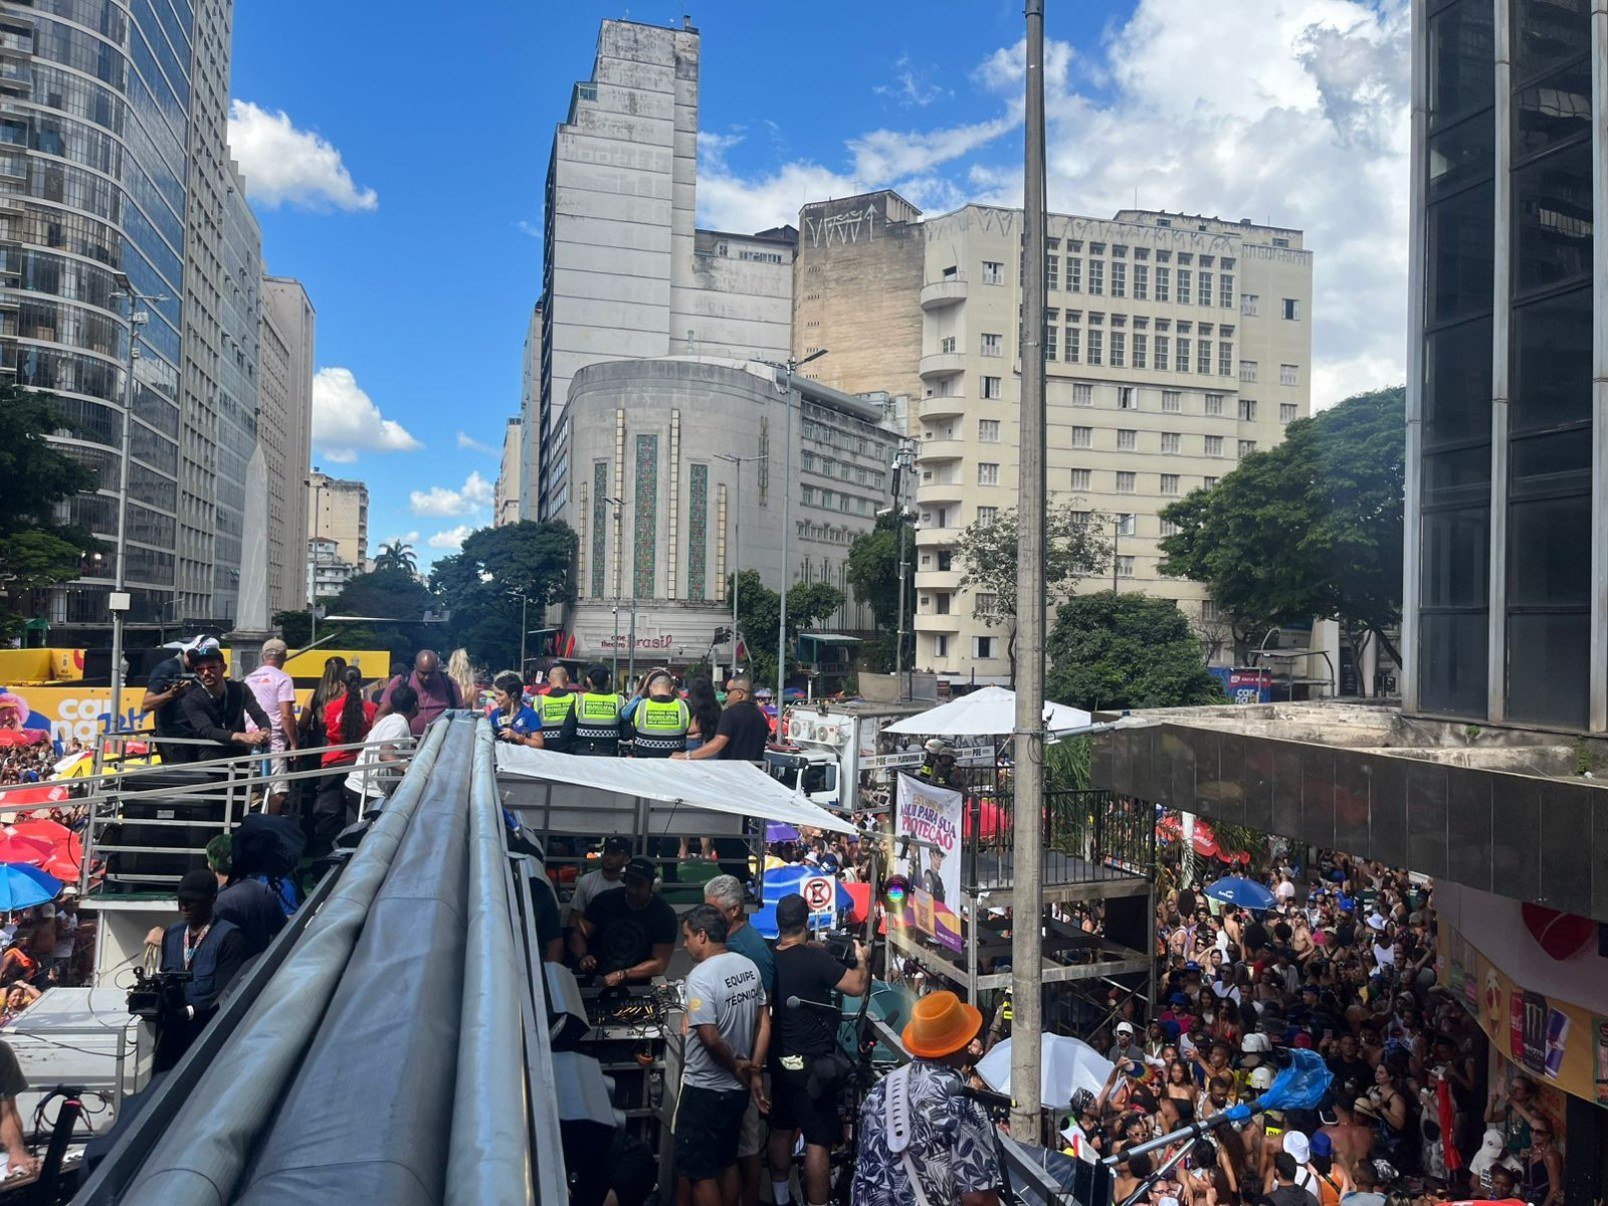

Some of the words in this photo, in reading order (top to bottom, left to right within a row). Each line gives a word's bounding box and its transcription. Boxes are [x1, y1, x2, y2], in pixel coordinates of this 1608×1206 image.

[917, 805, 938, 825] PARA
[938, 816, 956, 838] SUA
[725, 971, 755, 988] EQUIPE
